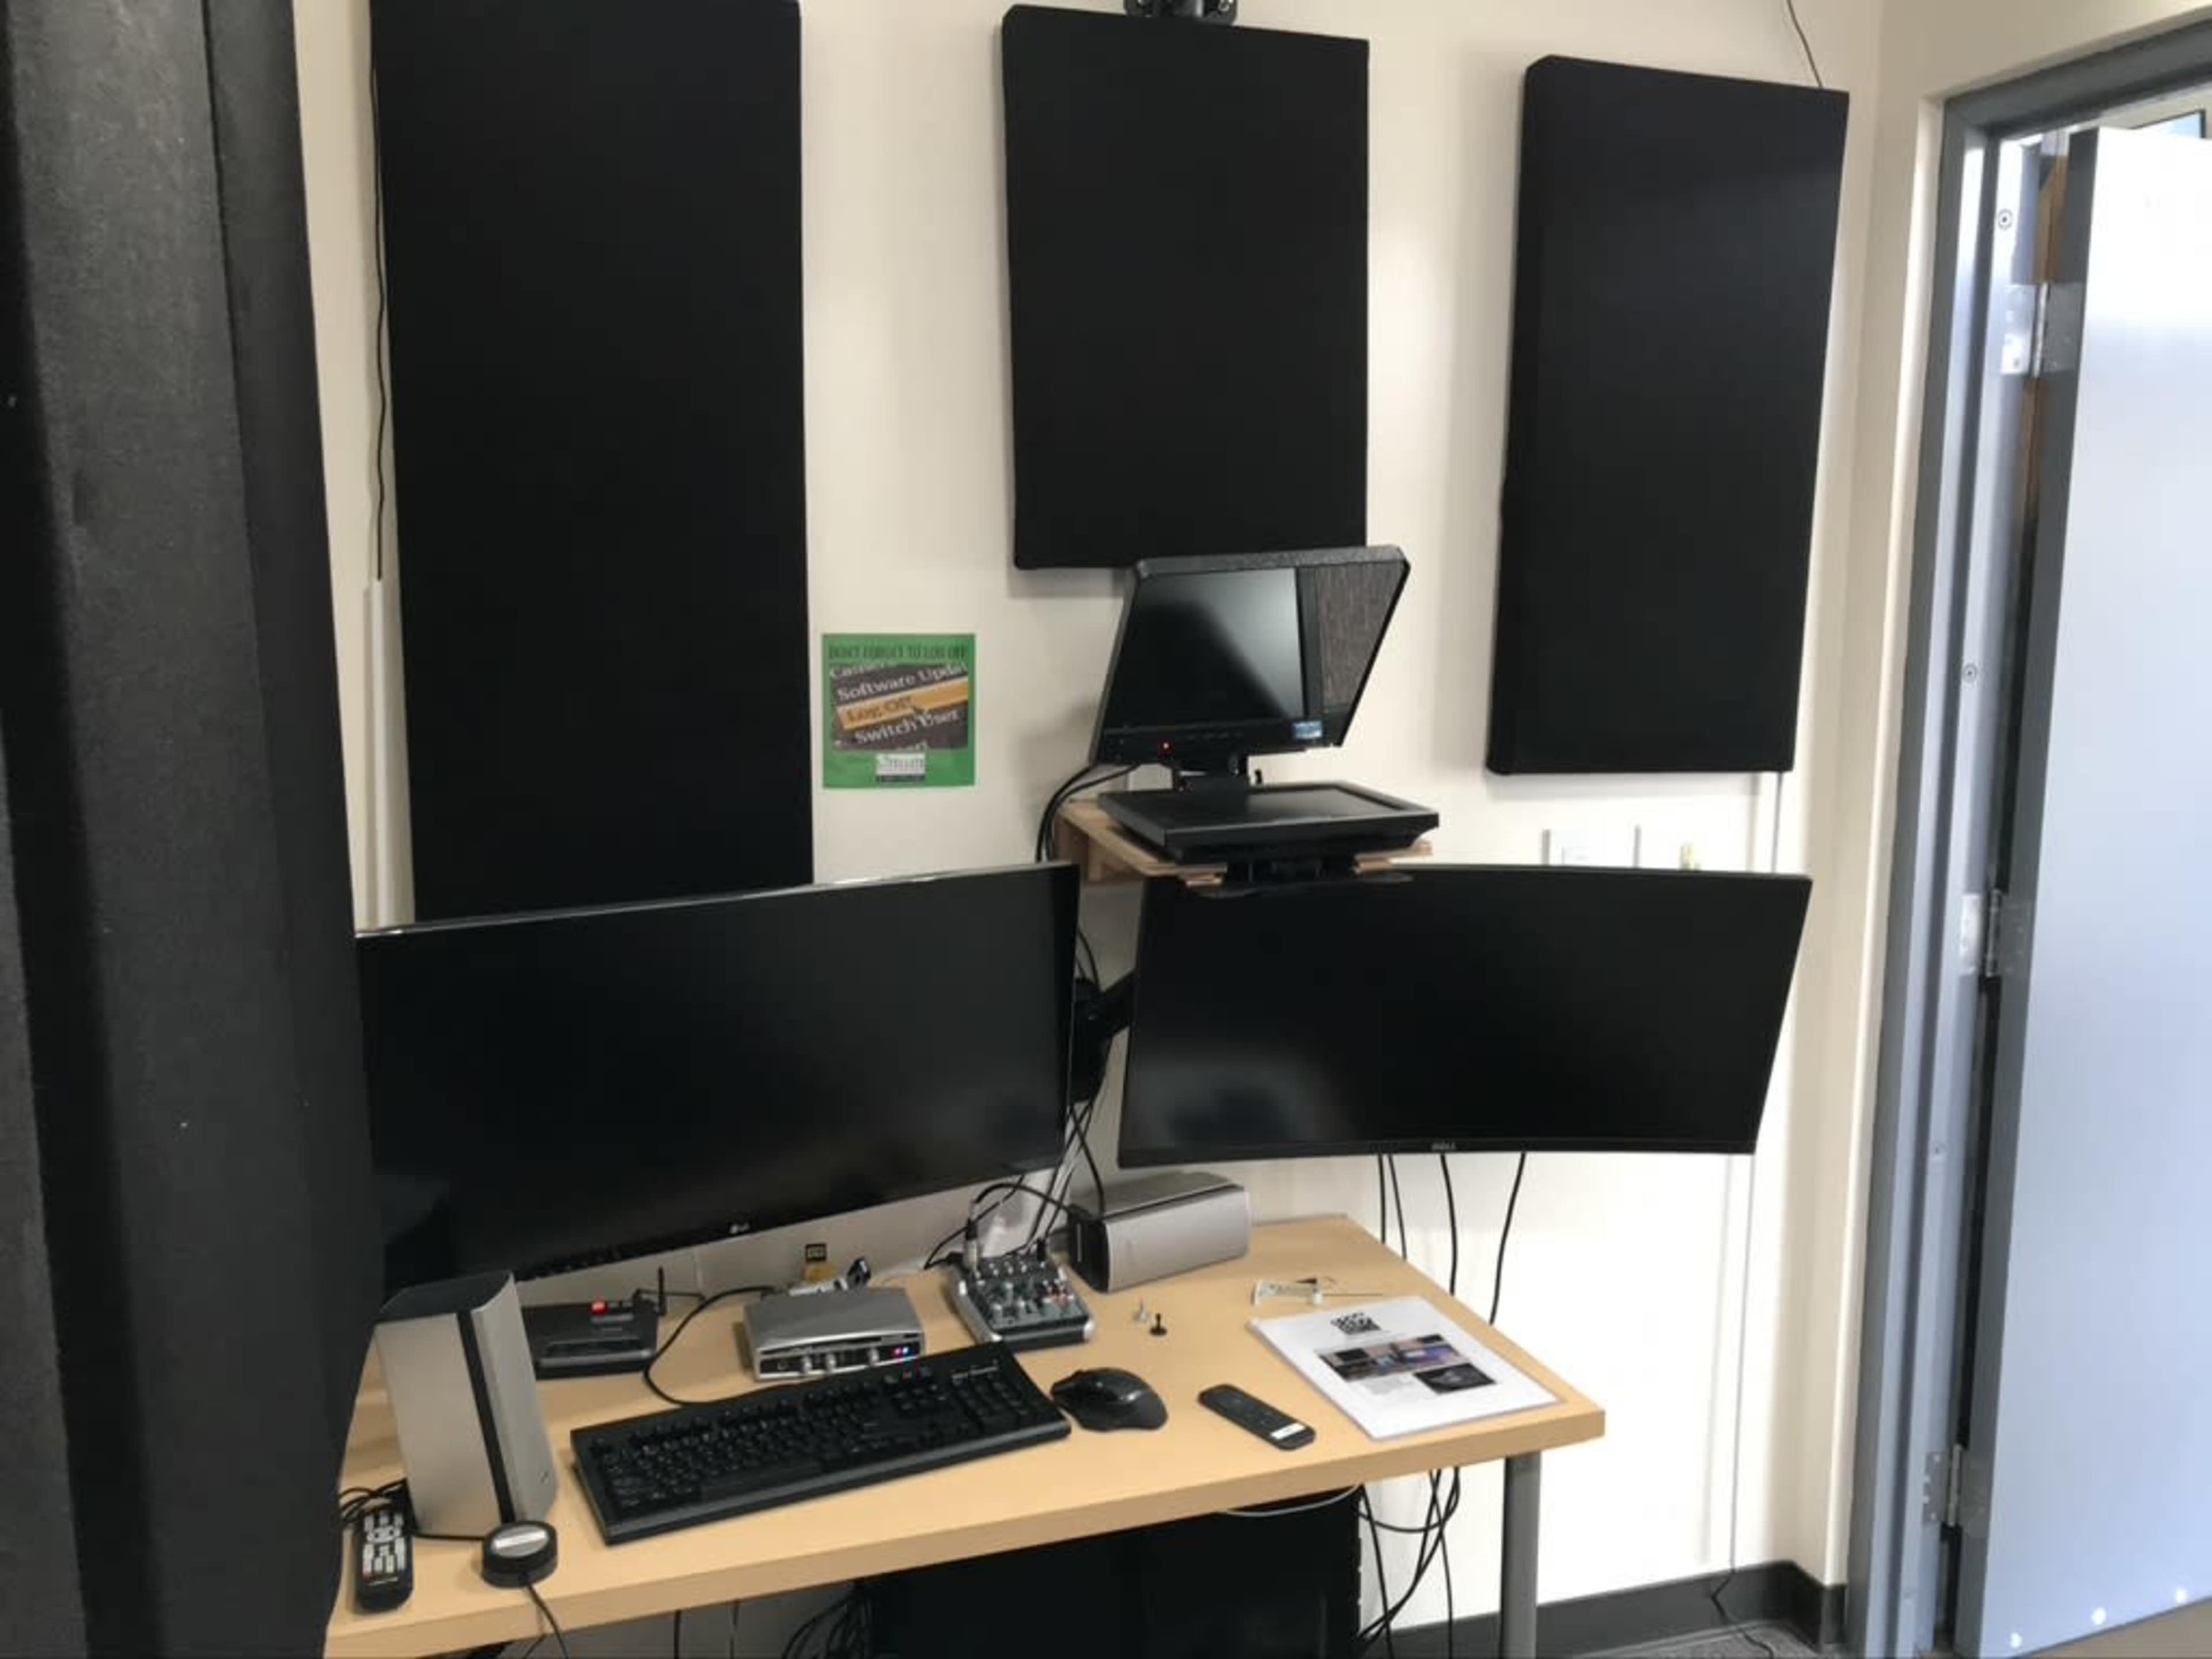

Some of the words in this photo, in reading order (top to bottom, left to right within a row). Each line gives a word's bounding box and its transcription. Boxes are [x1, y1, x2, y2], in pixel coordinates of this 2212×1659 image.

[837, 673, 916, 702] Software
[854, 715, 916, 744] Switch
[918, 707, 959, 728] User
